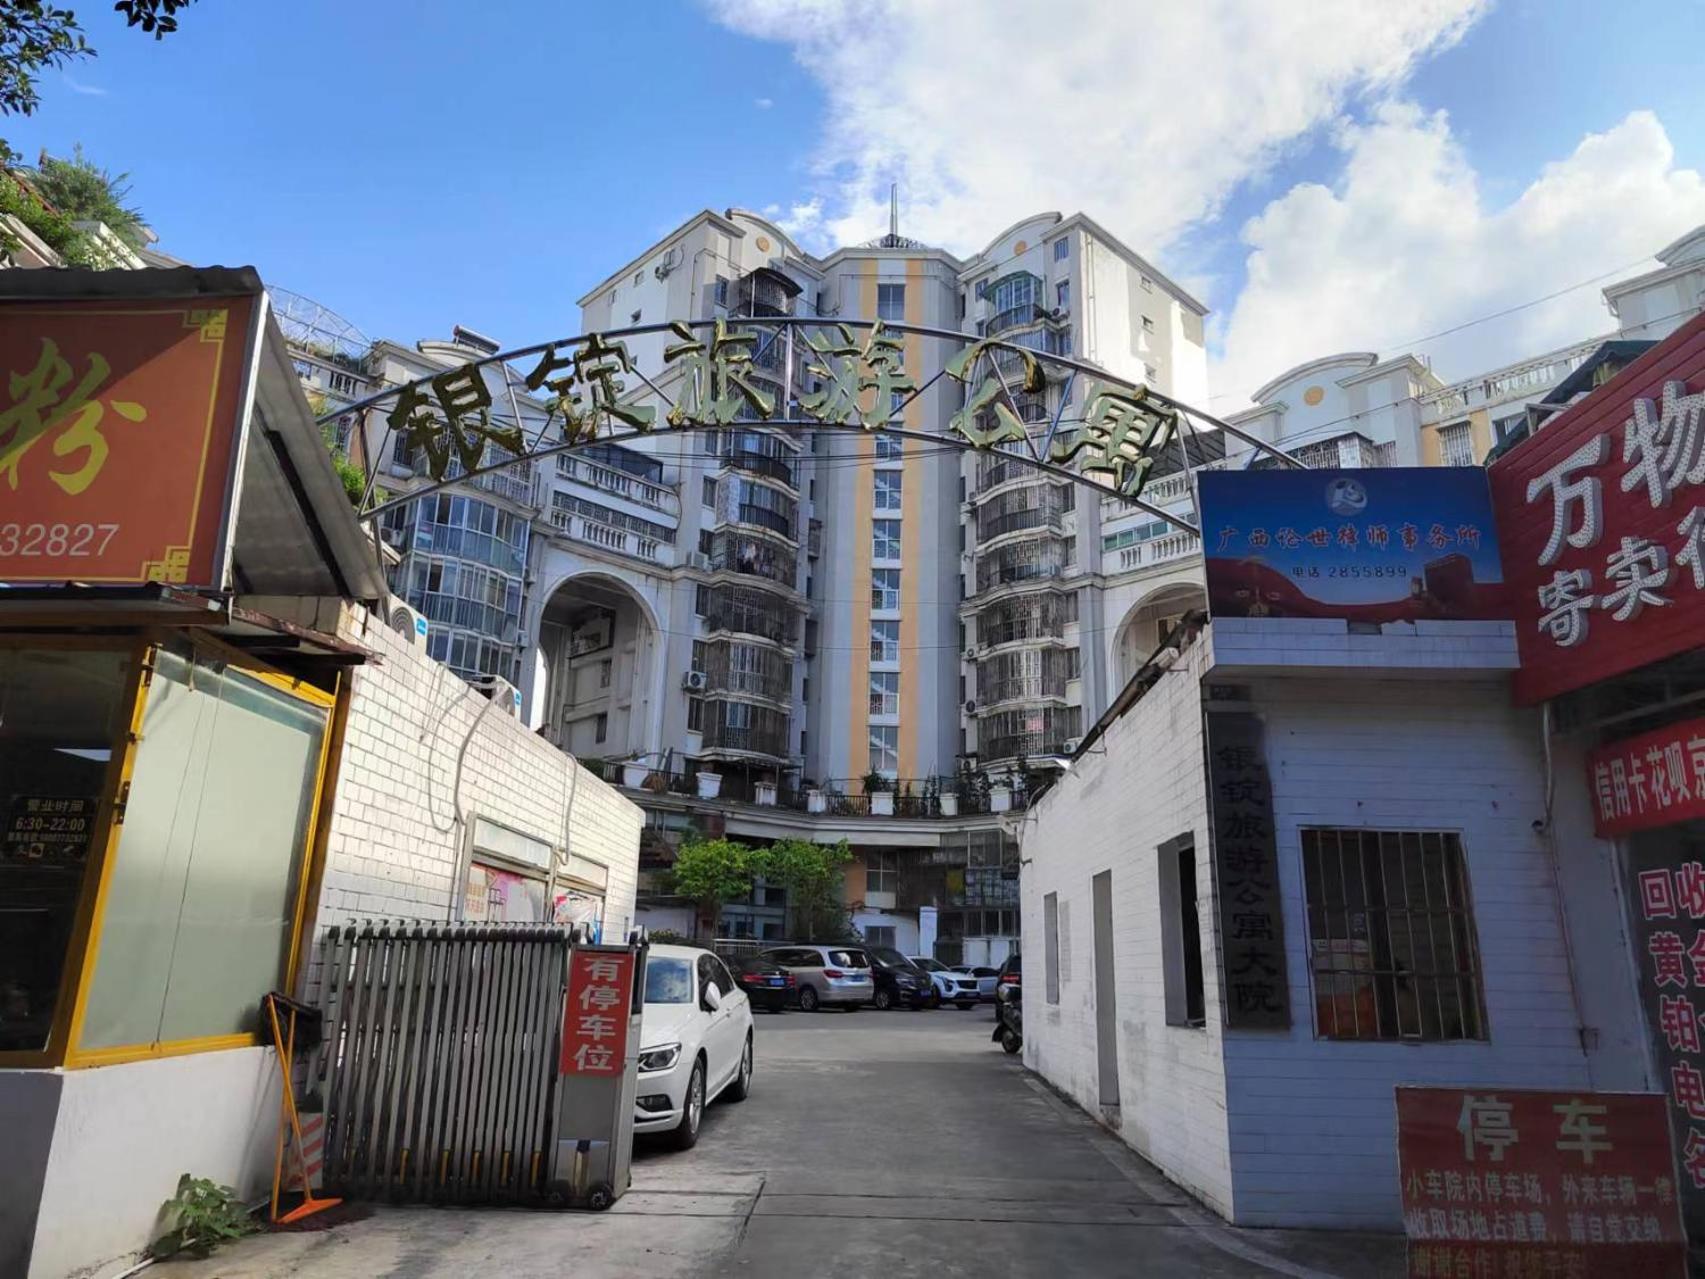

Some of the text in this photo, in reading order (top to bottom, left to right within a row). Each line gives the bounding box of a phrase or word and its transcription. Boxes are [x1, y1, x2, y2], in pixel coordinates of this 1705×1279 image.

[0, 523, 120, 556] 32827
[1292, 566, 1407, 578] 电话 2855899
[573, 957, 625, 1071] 有停车位
[1660, 995, 1705, 1053] 铂
[1457, 1095, 1612, 1164] 停车
